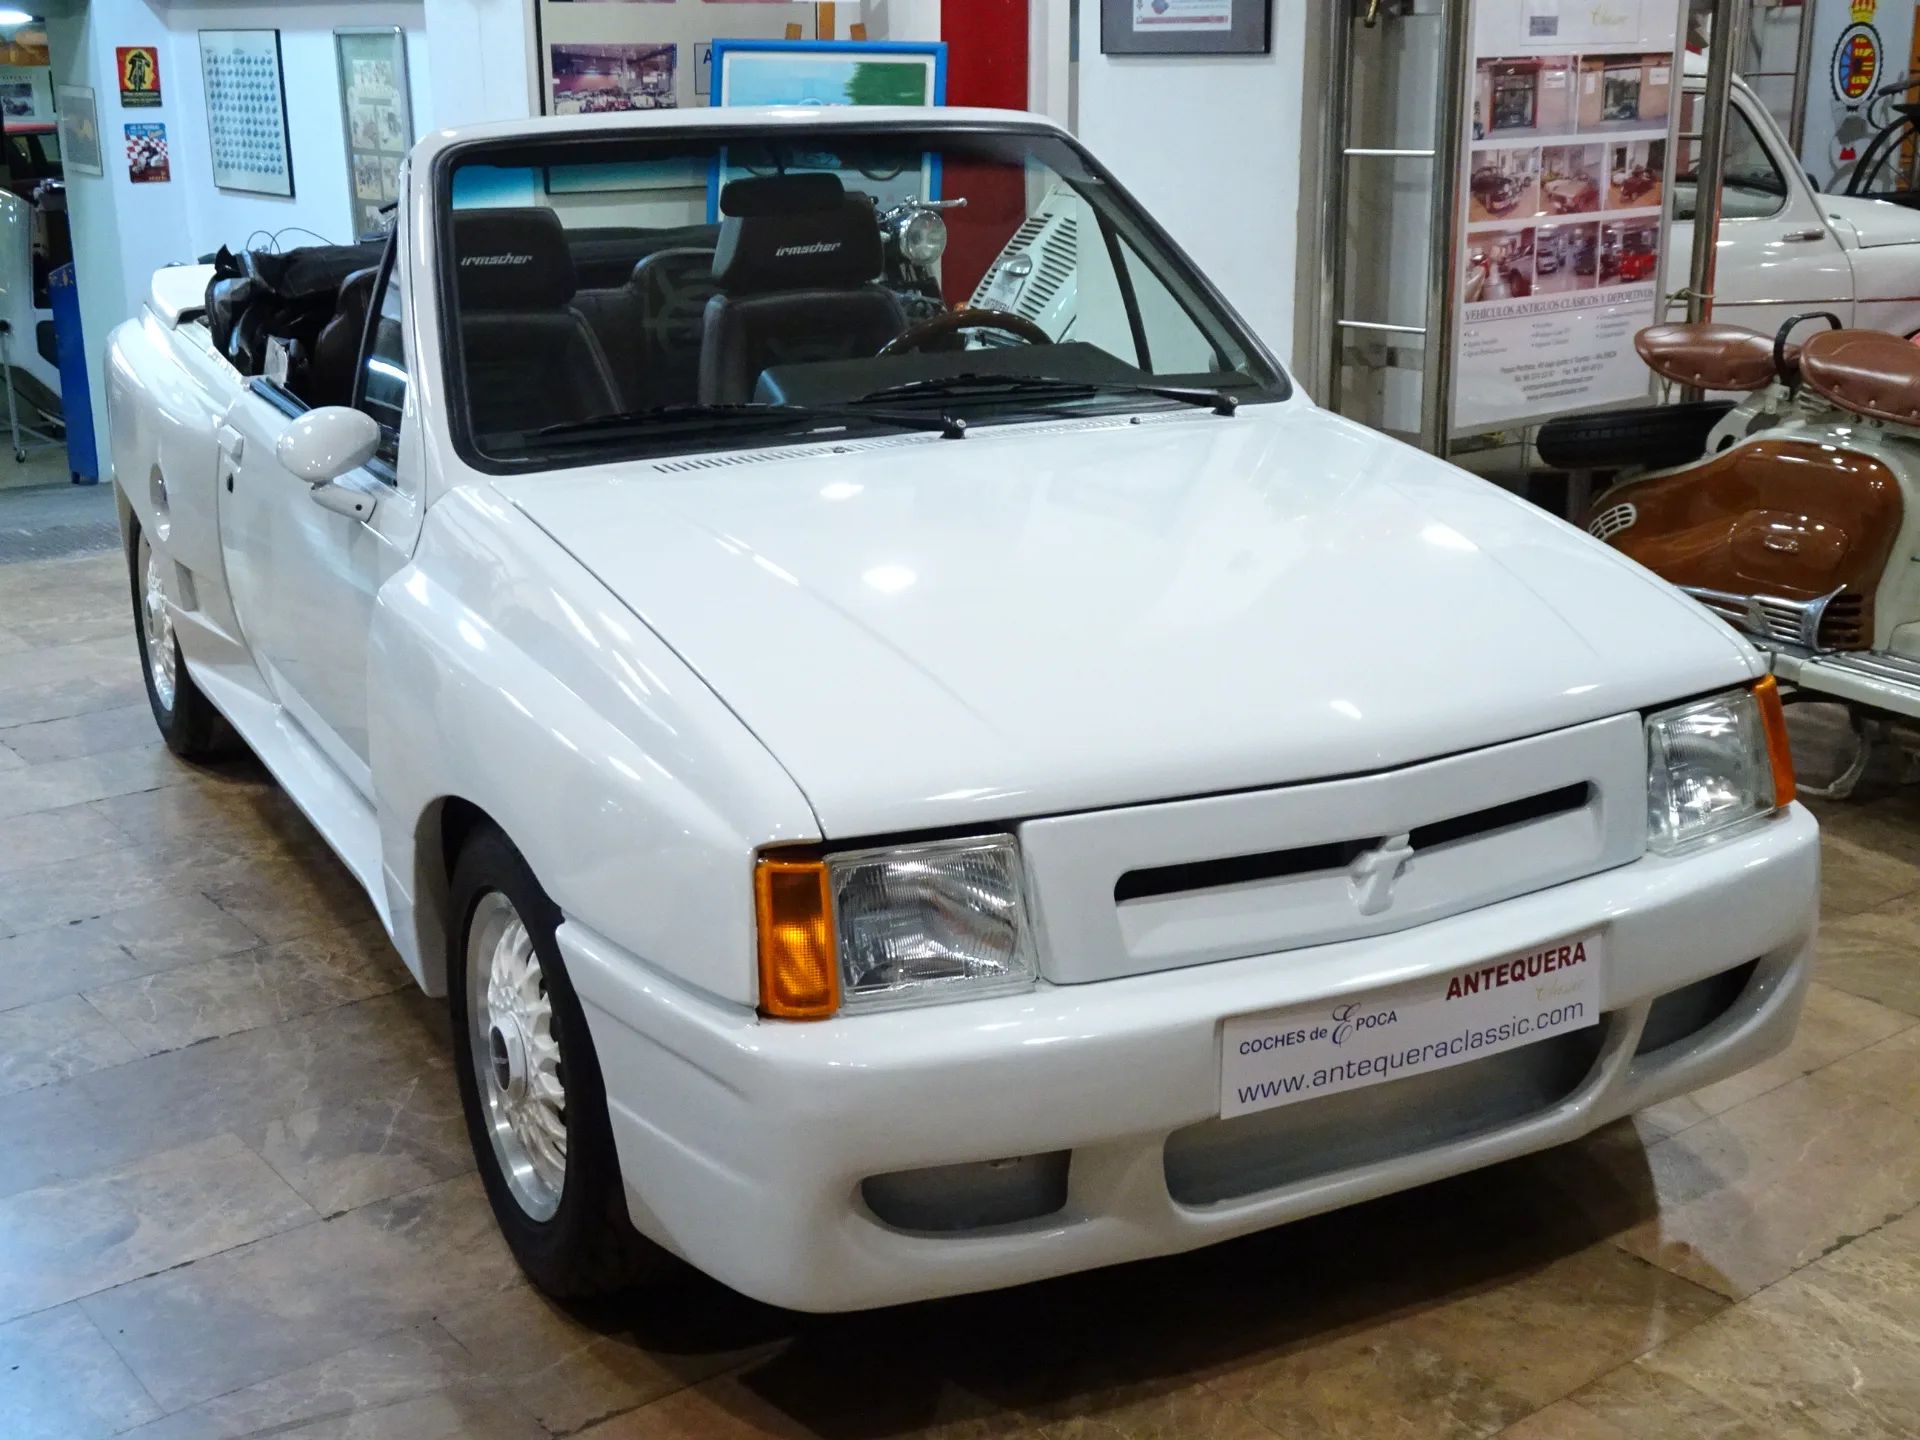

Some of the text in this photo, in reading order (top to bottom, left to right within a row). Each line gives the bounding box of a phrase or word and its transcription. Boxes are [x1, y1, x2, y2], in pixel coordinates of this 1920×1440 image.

[460, 252, 534, 266] irmscher
[776, 241, 841, 256] irmscher
[1446, 941, 1587, 1001] ANTEQUERA
[1238, 1000, 1584, 1104] www.antequeraclassic.com
[1239, 1029, 1306, 1055] COCHES
[1310, 1027, 1328, 1041] de
